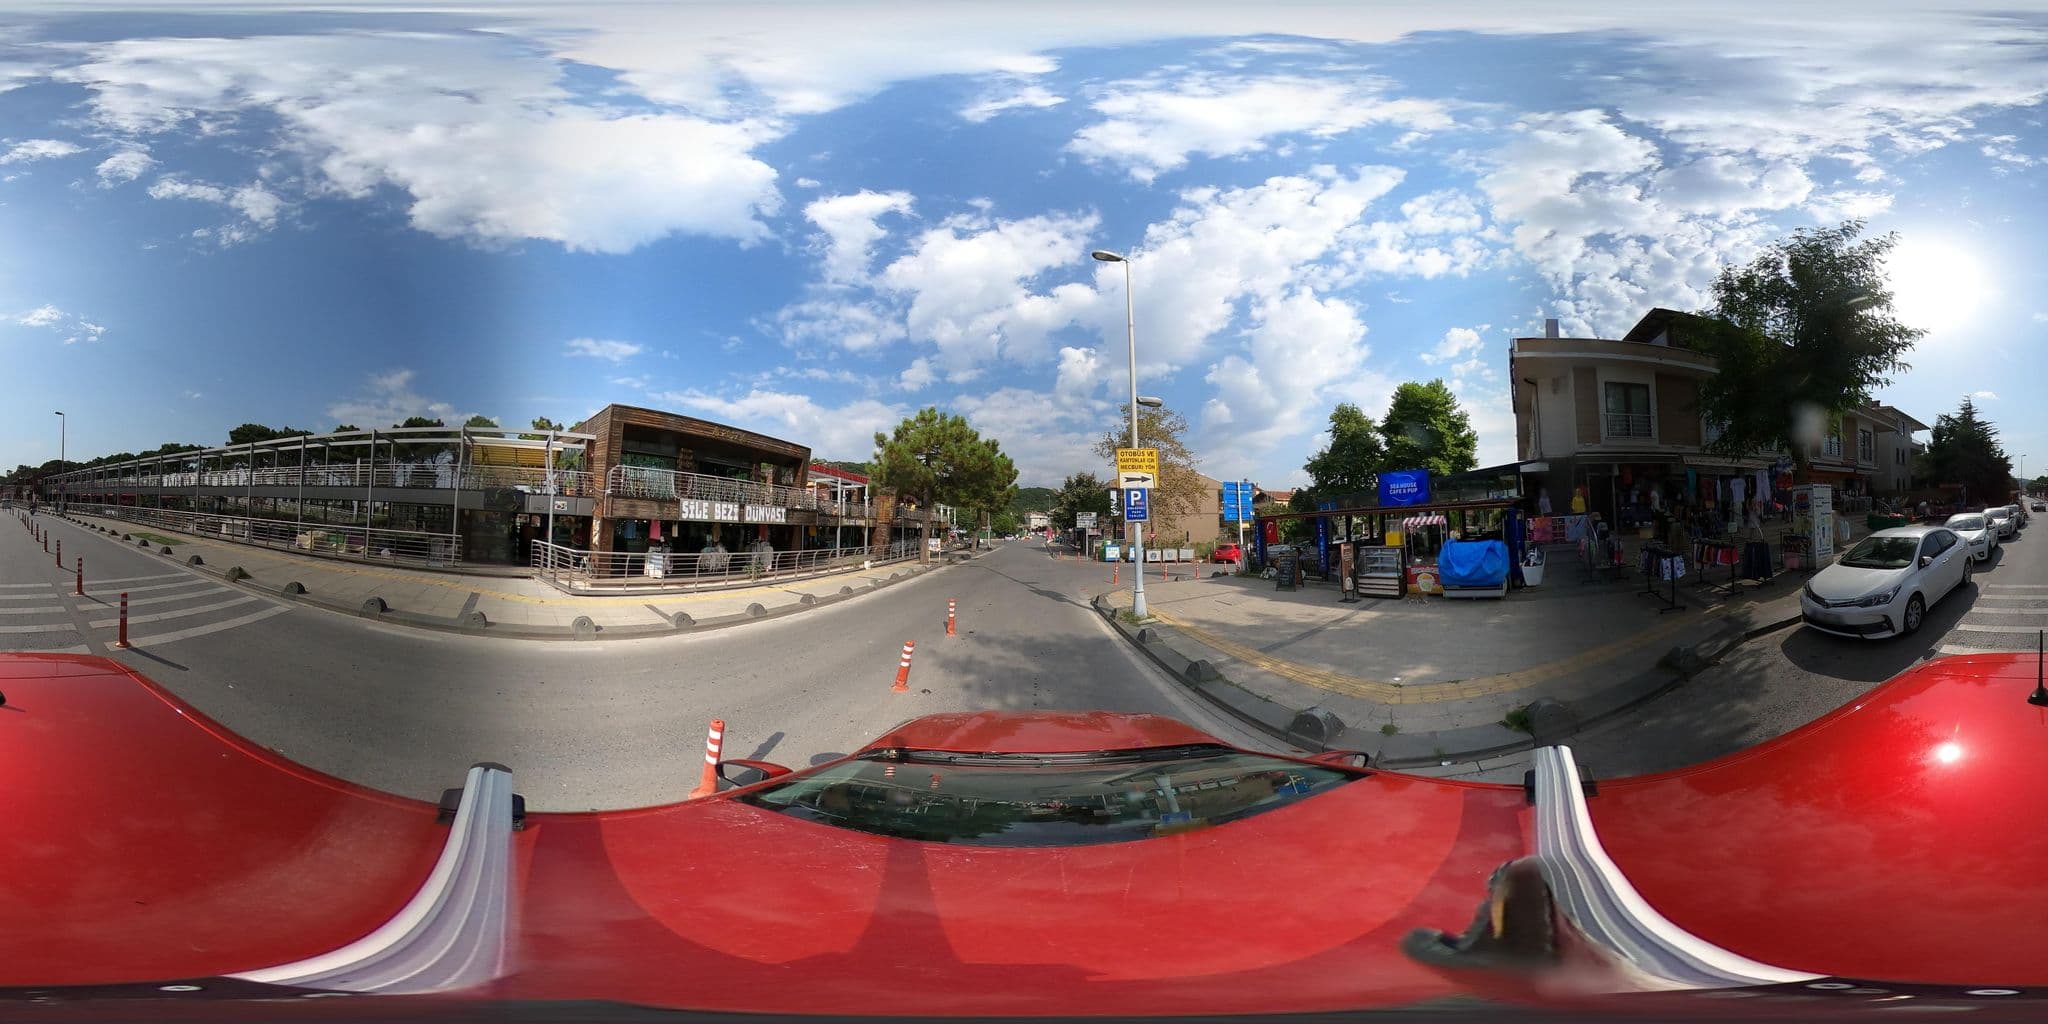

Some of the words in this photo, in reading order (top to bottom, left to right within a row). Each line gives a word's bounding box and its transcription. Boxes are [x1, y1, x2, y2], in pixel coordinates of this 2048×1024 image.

[1130, 490, 1142, 506] P
[714, 503, 739, 521] BEZİ
[745, 505, 786, 523] DÜNYASI
